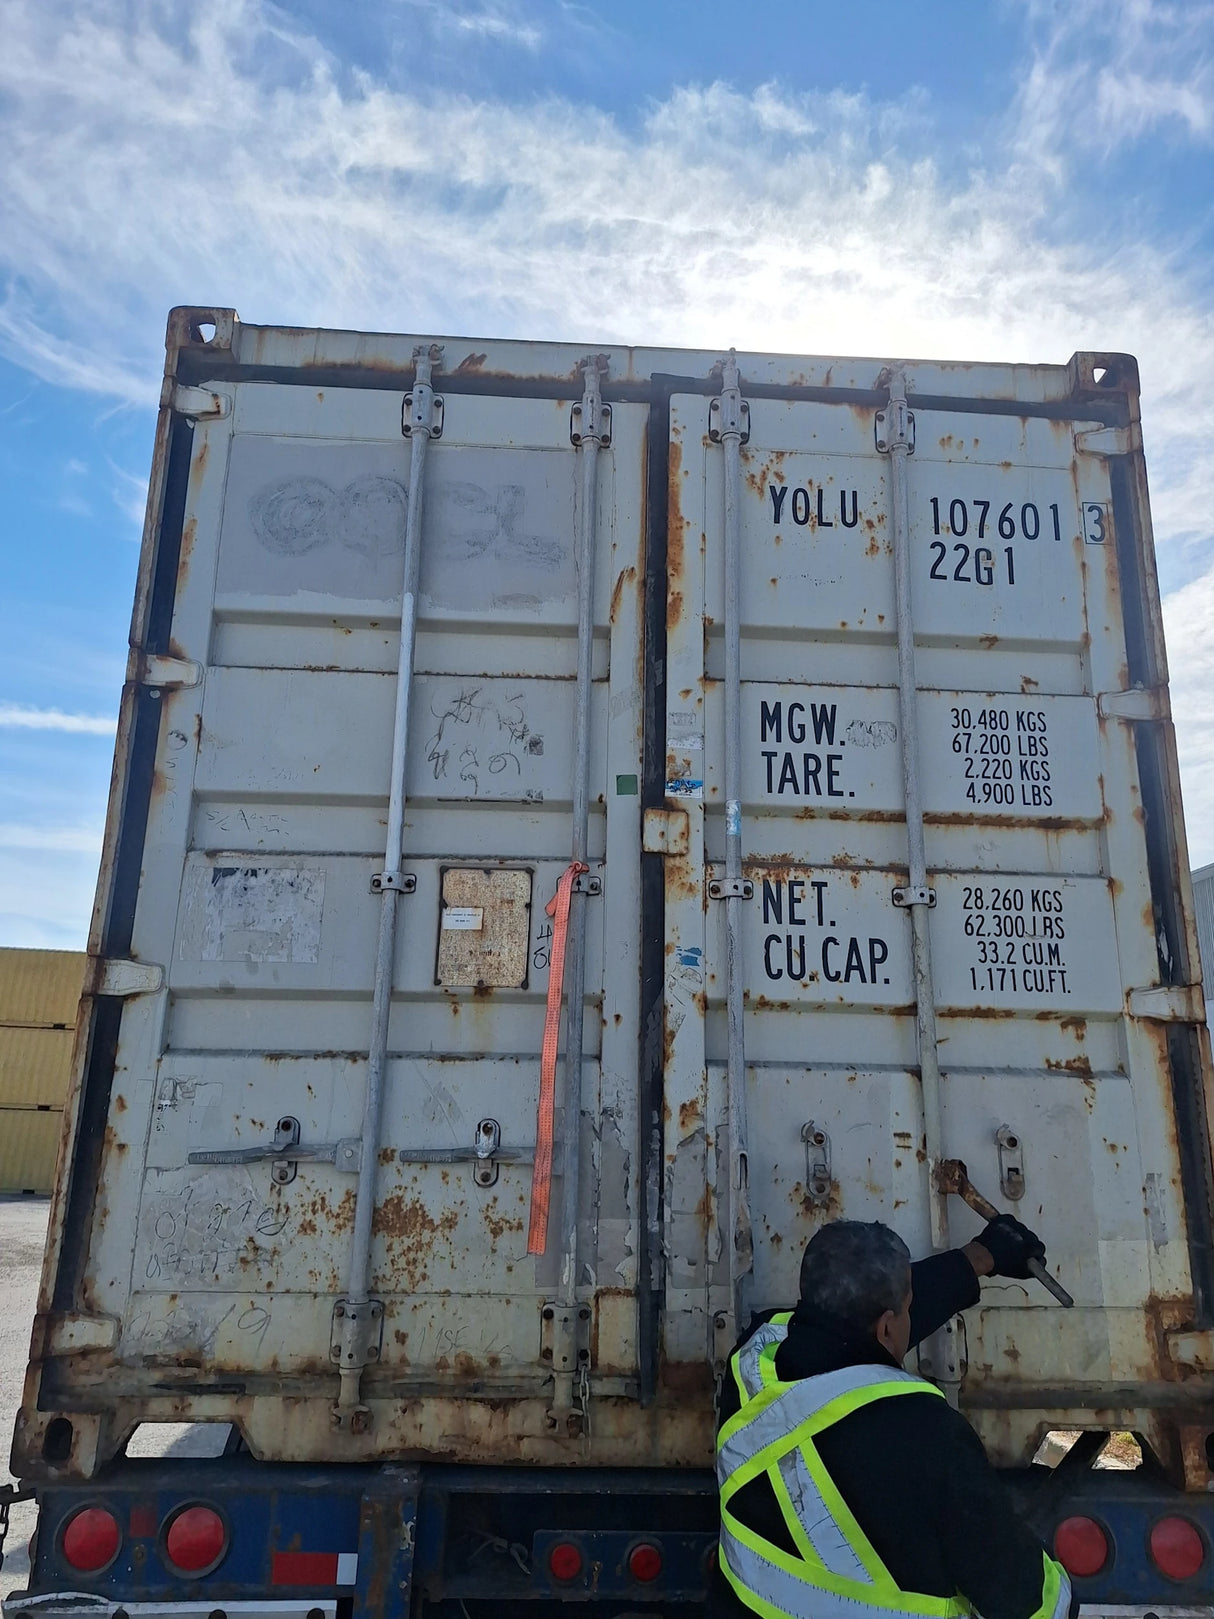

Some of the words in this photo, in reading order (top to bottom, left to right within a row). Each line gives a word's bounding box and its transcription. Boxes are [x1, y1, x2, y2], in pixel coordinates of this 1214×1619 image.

[768, 484, 859, 528] YOLU
[929, 496, 1061, 542] 107601
[1086, 504, 1107, 543] 3
[929, 540, 1015, 586] 22G1
[760, 700, 846, 747] MGW.
[950, 707, 1009, 732] 30,480
[1016, 710, 1048, 733] KGS
[951, 733, 1011, 757] 67,200
[1017, 735, 1049, 758] LBS
[760, 750, 856, 798] TARE.
[964, 756, 1013, 780] 2,220
[1019, 759, 1051, 782] KGS
[966, 781, 1015, 805] 4,900
[1021, 783, 1053, 807] LBS
[762, 879, 836, 927] NET.
[962, 886, 1024, 912] 28,260
[1030, 889, 1063, 913] KGS
[964, 914, 1025, 938] 62,300
[763, 933, 890, 985] CU.CAP.
[976, 940, 1017, 965] 33.2
[1022, 942, 1066, 967] CU.M.
[969, 966, 1017, 992] 1,171
[1022, 968, 1072, 994] CU.FT.
